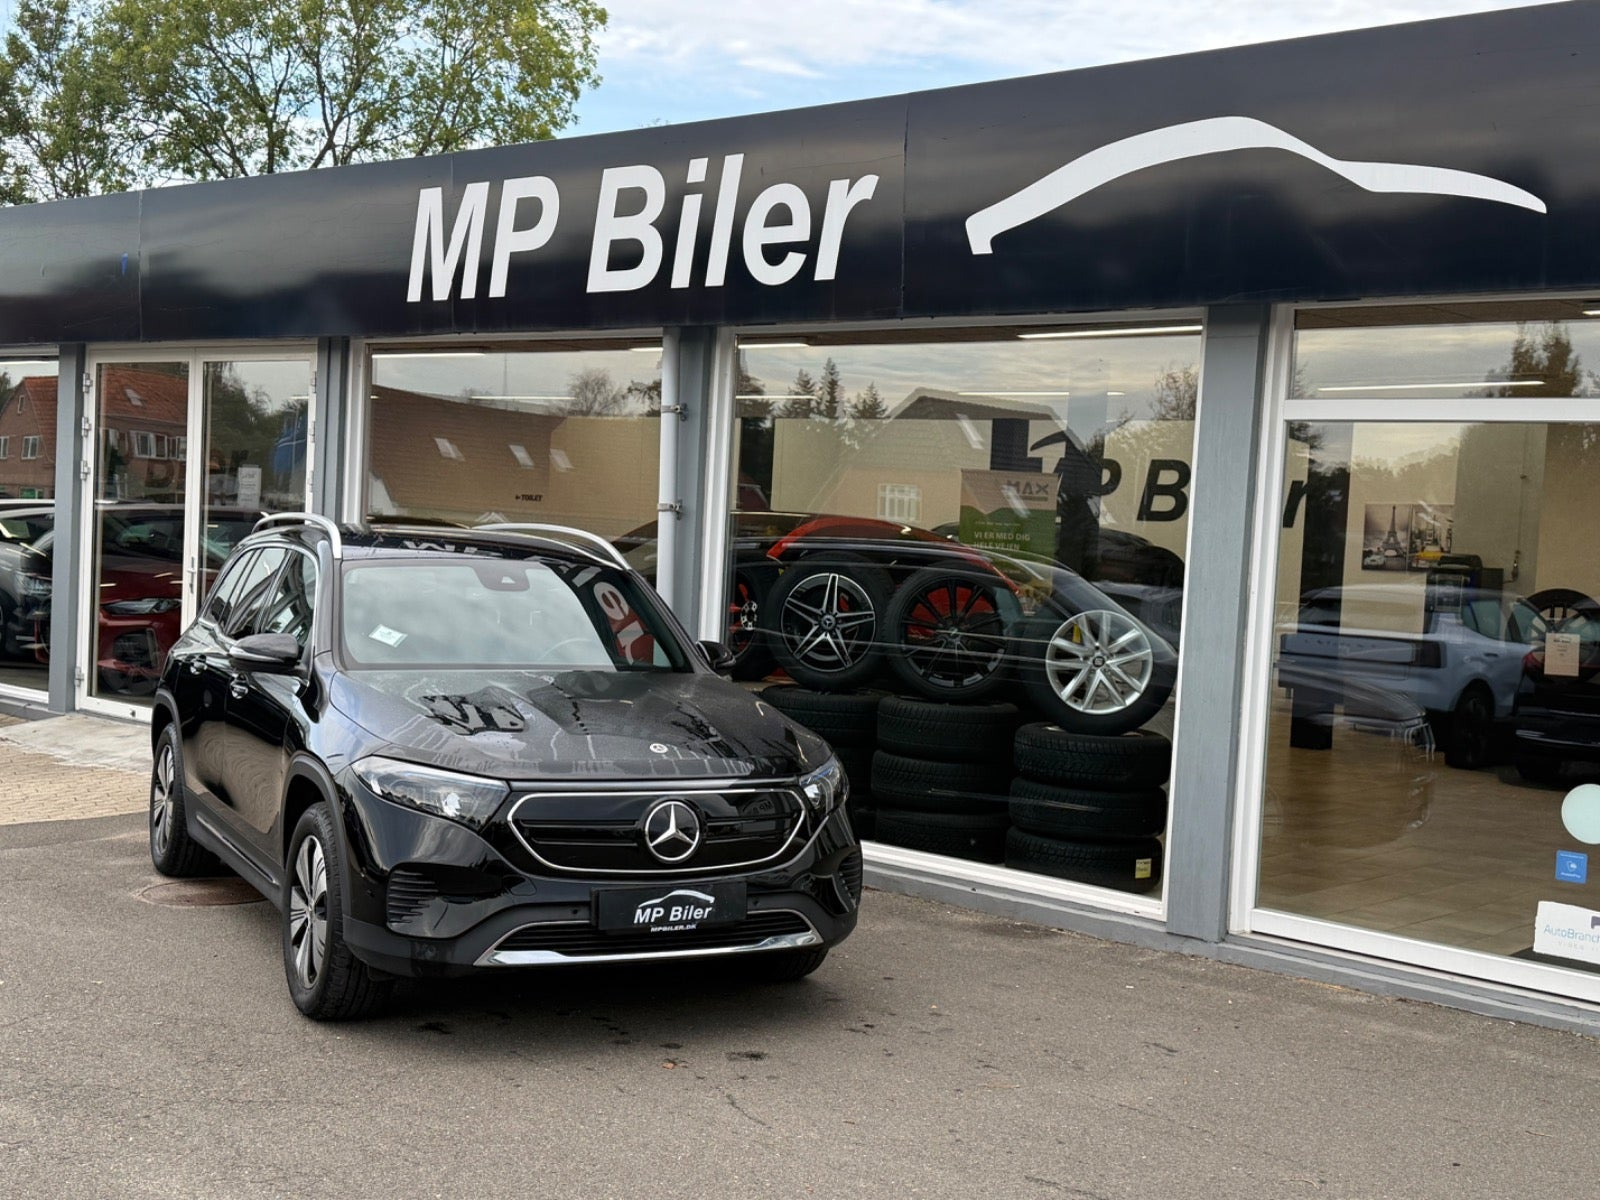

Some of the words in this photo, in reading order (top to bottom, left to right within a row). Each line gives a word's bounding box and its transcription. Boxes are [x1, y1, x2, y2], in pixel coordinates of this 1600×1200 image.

[406, 175, 560, 302] MP
[586, 153, 879, 294] Biler
[996, 532, 1014, 540] MED
[1016, 533, 1031, 541] DIG
[633, 907, 664, 924] MP
[669, 905, 713, 921] Biler
[650, 923, 697, 933] MPBILER.DK
